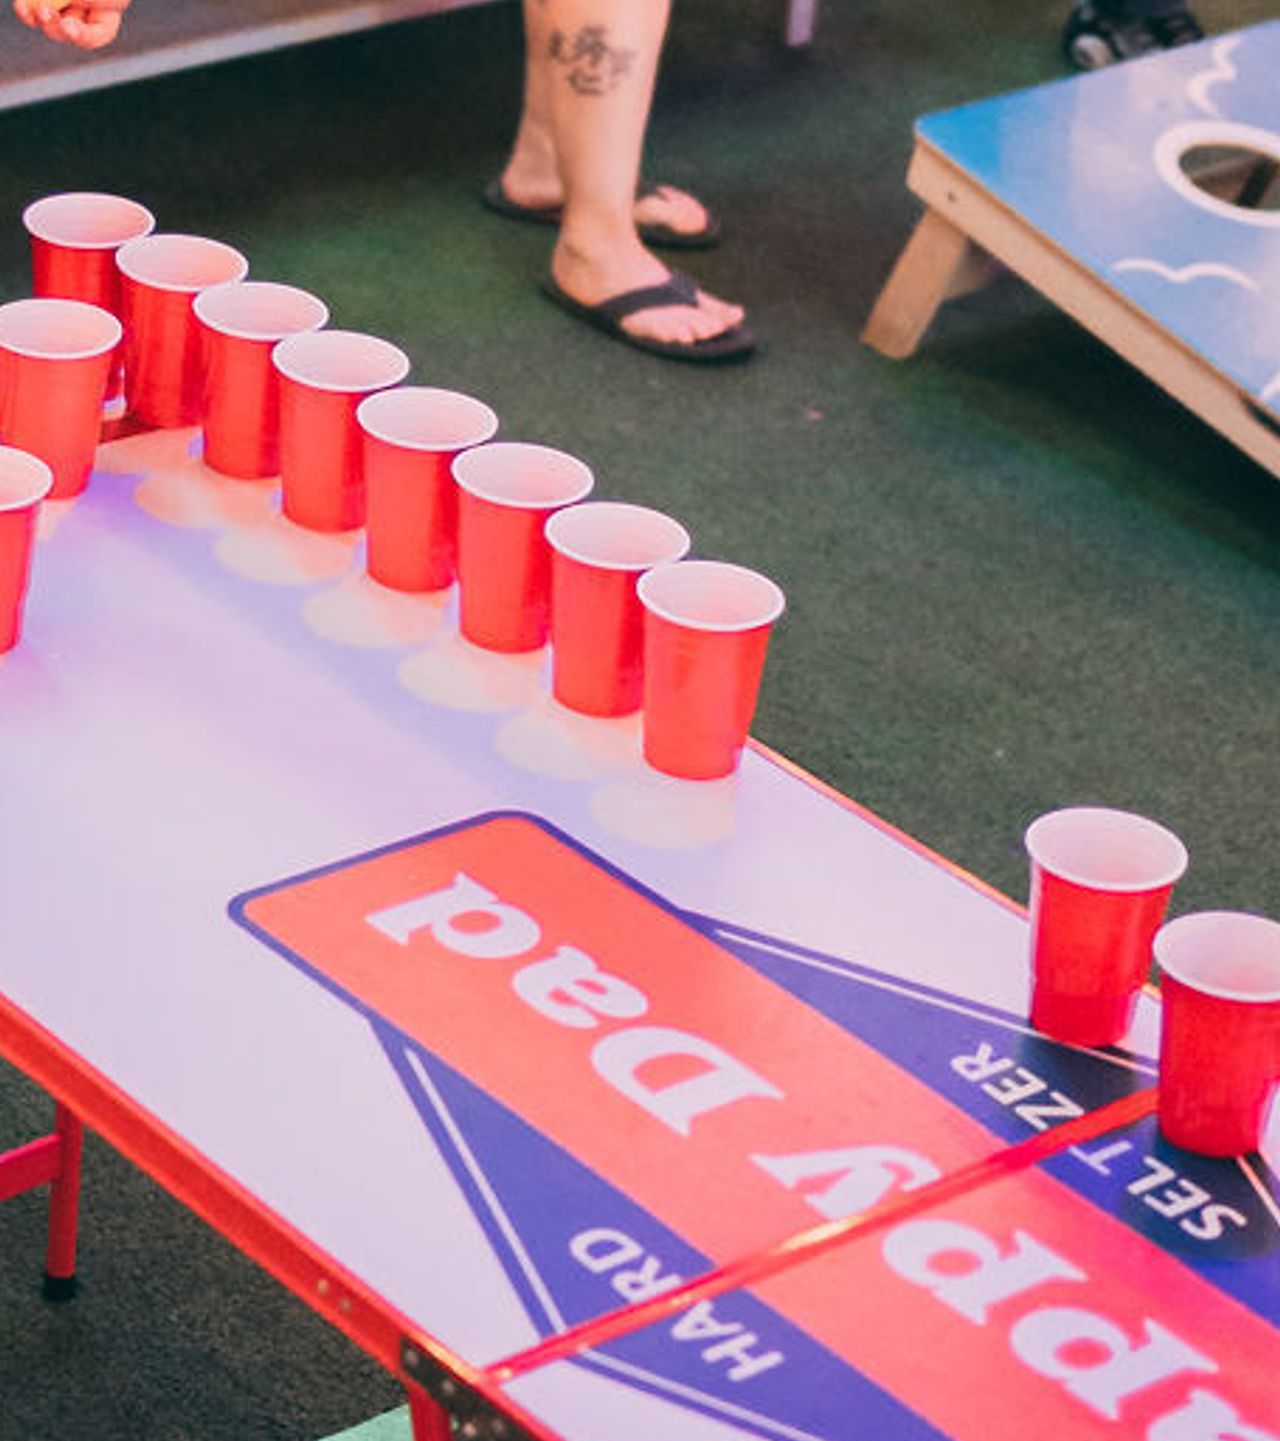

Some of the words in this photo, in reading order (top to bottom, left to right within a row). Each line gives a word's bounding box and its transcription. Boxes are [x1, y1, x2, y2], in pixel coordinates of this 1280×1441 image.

[365, 871, 786, 1137] Dad
[950, 1042, 1249, 1231] SELTZER
[569, 1227, 785, 1383] HARD
